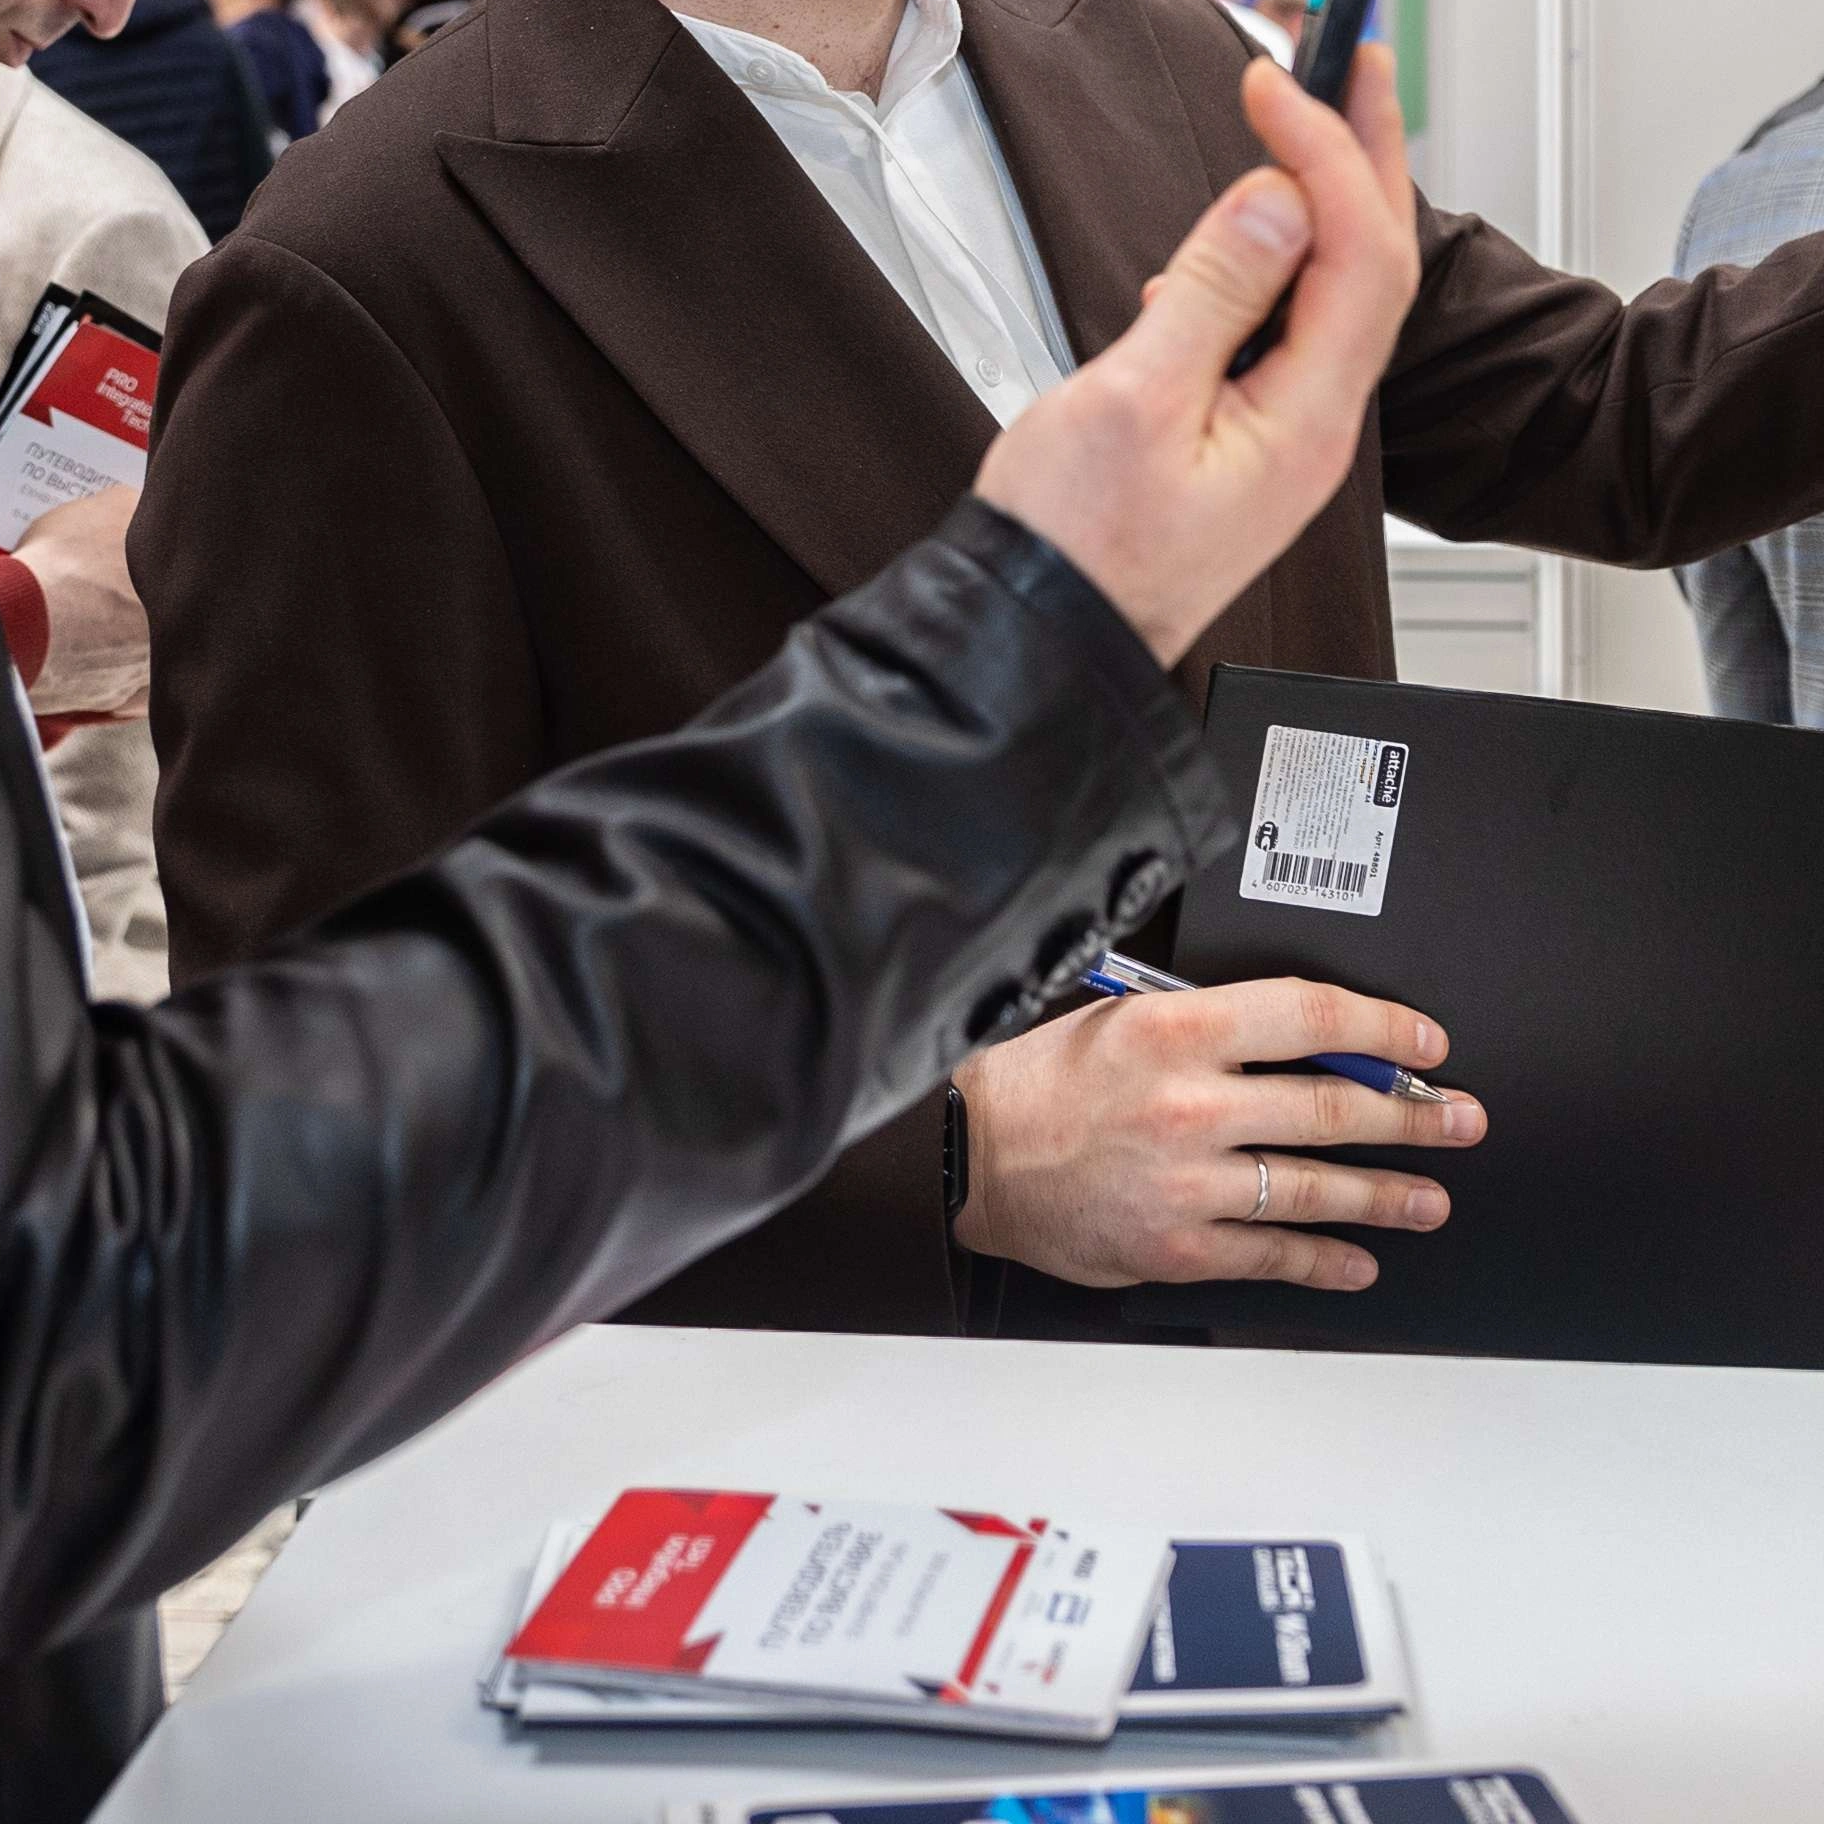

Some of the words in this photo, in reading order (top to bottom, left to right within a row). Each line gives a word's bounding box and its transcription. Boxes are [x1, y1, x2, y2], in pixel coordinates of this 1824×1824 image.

[102, 366, 138, 393] PRO
[96, 381, 153, 417] Integratio
[22, 461, 46, 481] ПО
[1381, 749, 1401, 804] attaché
[1265, 880, 1308, 896] 607023
[1315, 888, 1355, 902] 143101
